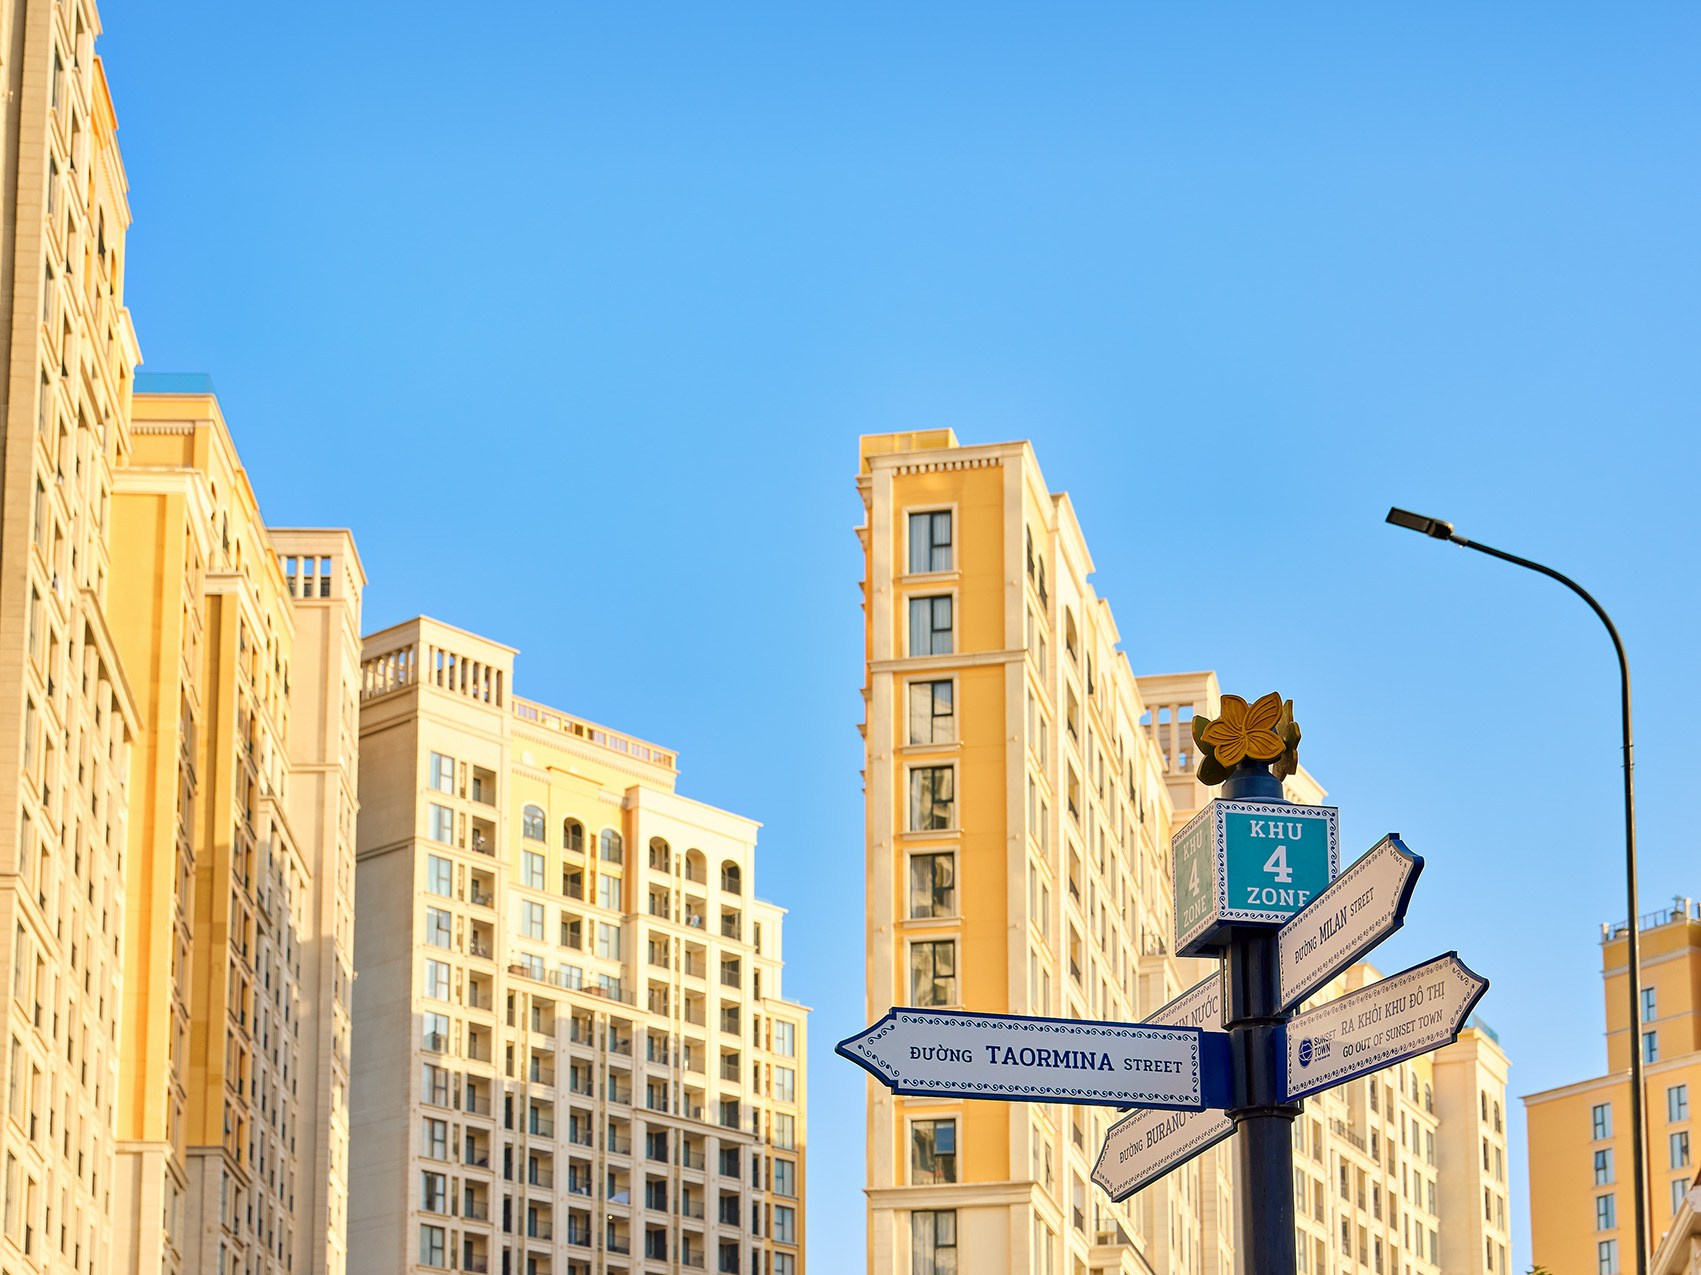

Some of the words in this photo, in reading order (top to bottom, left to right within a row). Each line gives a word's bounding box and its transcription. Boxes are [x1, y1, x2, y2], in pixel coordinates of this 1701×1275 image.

[1183, 829, 1203, 861] KHU
[1250, 820, 1303, 840] KHU
[1188, 858, 1200, 897] 4
[1263, 845, 1293, 883] 4
[1183, 894, 1207, 928] ZONE
[1319, 906, 1348, 945] MILAN
[1350, 887, 1374, 917] STREET
[1341, 1020, 1355, 1036] RA
[1358, 1004, 1382, 1029] KHỎI
[1385, 996, 1407, 1019] KHU
[1409, 986, 1424, 1010] ĐÔ
[1427, 981, 1445, 1002] THỊ
[1313, 1029, 1336, 1046] SUNSET
[1314, 1043, 1331, 1057] TOWN
[1342, 1046, 1352, 1058] GO
[1355, 1038, 1372, 1054] OUT
[1373, 1032, 1383, 1047] OF
[1386, 1020, 1416, 1042] SUNSET
[1418, 1009, 1443, 1028] TOWN
[910, 1044, 973, 1063] ĐƯỜNG
[986, 1045, 1114, 1071] TAORMINA
[1123, 1058, 1183, 1074] STREET
[1146, 1111, 1187, 1148] BURANO
